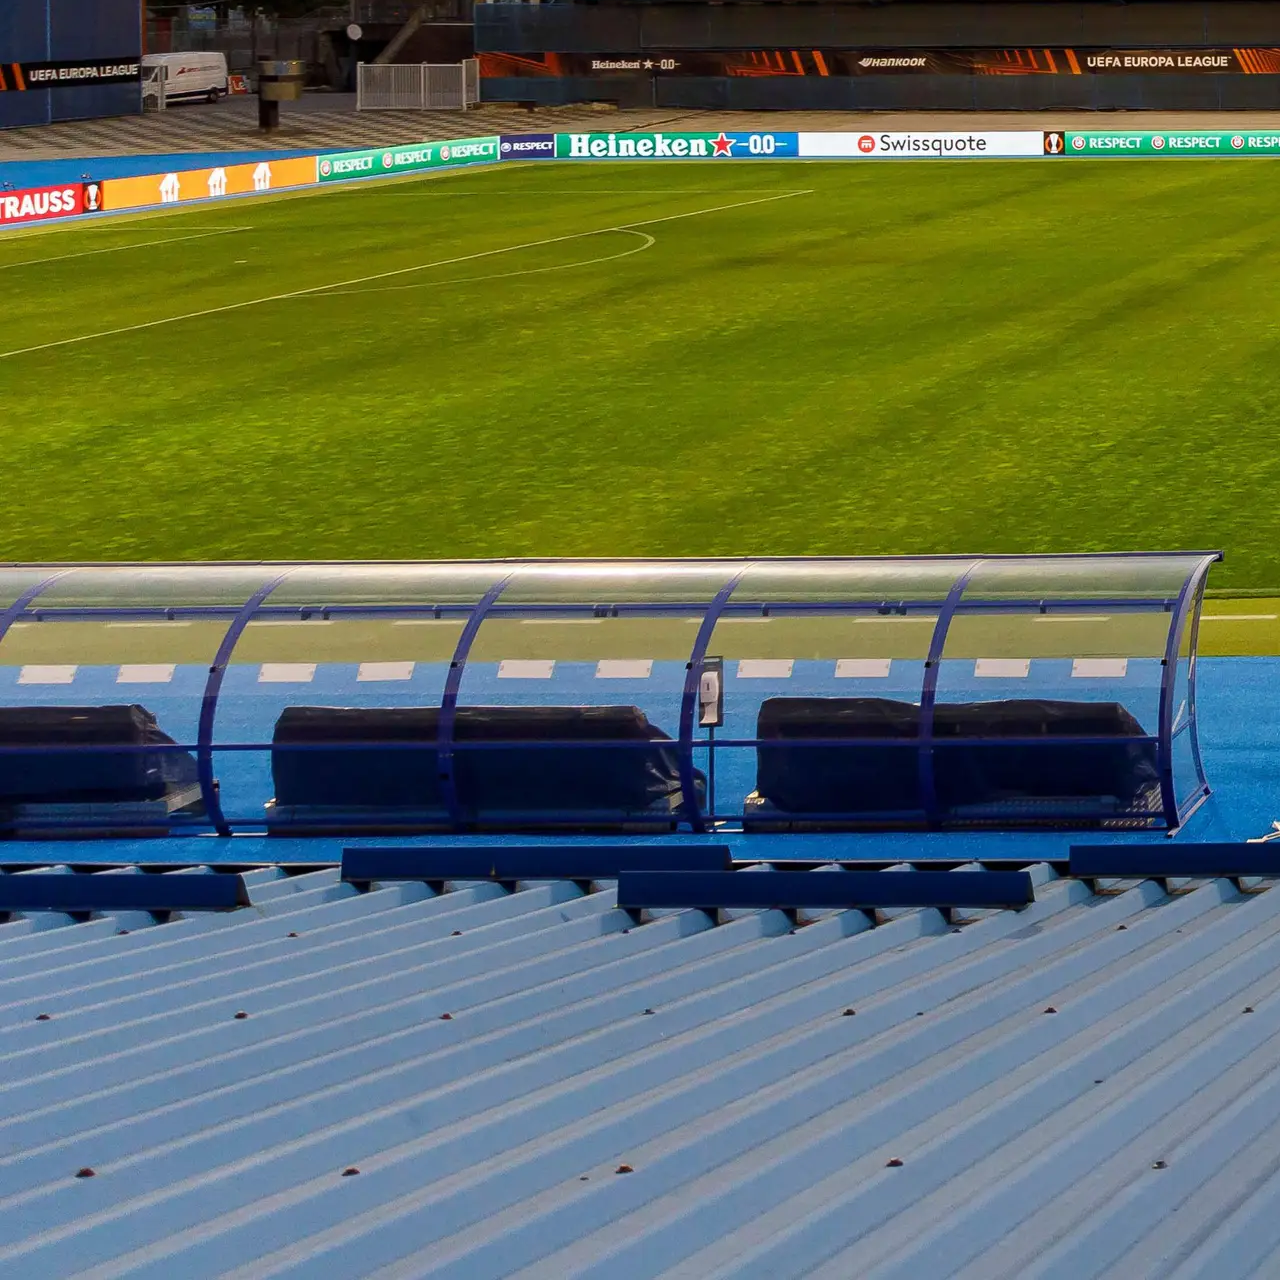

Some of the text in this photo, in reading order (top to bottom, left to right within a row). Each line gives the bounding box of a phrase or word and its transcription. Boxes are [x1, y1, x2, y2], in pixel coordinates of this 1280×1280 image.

[592, 60, 640, 69] Heineken
[1088, 57, 1228, 66] UEFA EUROPA LEAGUE
[30, 64, 139, 81] UEFA EUROPA LEAGUE
[452, 141, 496, 157] RESPECT
[513, 142, 553, 150] RESPECT
[569, 133, 708, 157] Heineken
[880, 134, 987, 156] Swissquote
[1089, 135, 1142, 148] RESPECT
[1169, 135, 1221, 148] RESPECT
[334, 157, 374, 173] RESPECT
[394, 149, 432, 166] RESPECT
